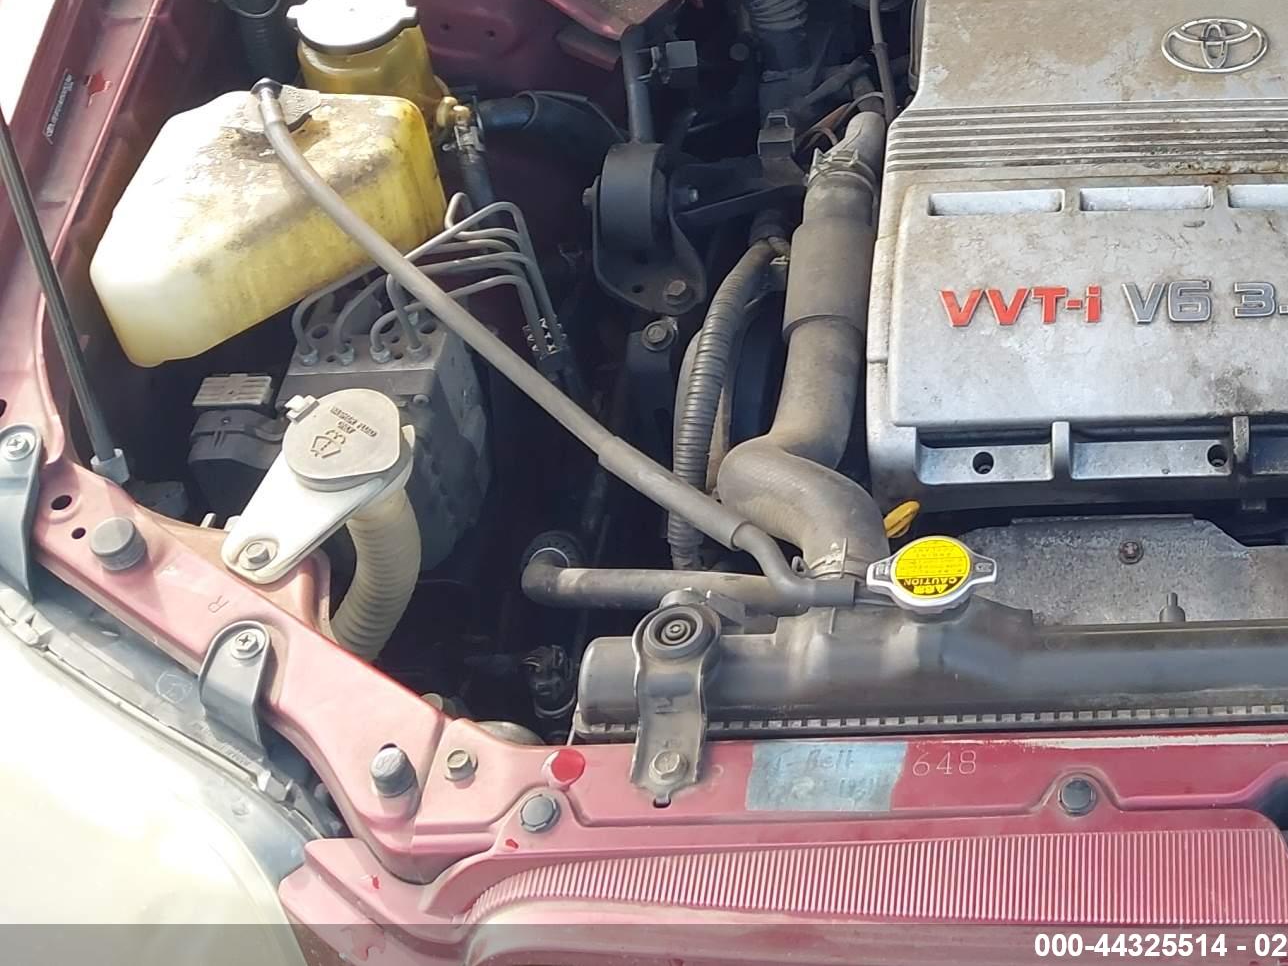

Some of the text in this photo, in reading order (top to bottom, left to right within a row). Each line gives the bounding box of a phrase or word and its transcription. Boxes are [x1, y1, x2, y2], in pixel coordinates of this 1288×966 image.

[939, 284, 1101, 327] VVT-i
[1121, 280, 1212, 324] V6
[903, 577, 958, 586] CAUTION
[912, 750, 977, 777] 648
